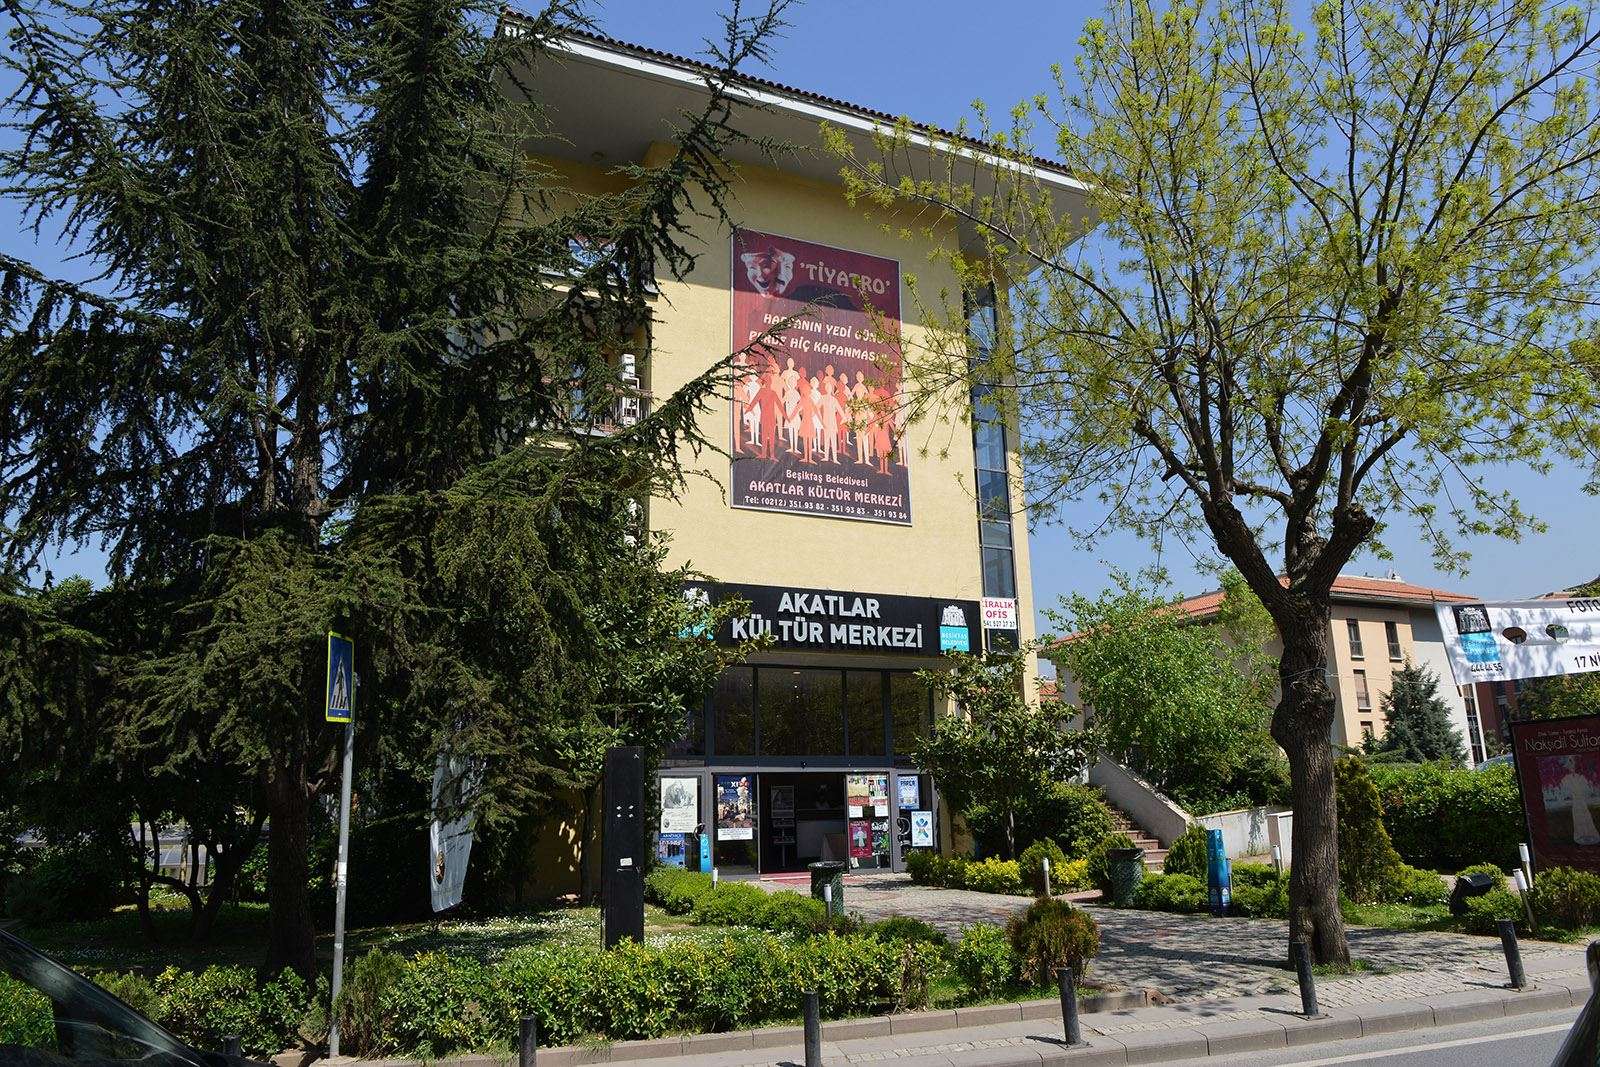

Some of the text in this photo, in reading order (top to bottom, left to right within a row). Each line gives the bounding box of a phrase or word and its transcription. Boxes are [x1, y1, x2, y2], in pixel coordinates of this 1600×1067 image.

[826, 324, 852, 338] YEDİ
[790, 336, 811, 352] HİÇ
[786, 469, 868, 487] Beşiktaş Belediyesi
[749, 480, 903, 507] AKATLAR KÜLTÜR MERKEZİ
[745, 495, 760, 504] Tel:
[761, 497, 787, 507] (0212)
[873, 509, 886, 517] 351
[778, 592, 880, 619] AKATLAR
[982, 600, 1013, 609] İRALIK
[986, 609, 1008, 618] OFİS
[732, 613, 824, 644] KÜLTÜR
[830, 623, 923, 649] MERKEZİ
[1574, 656, 1586, 668] 17
